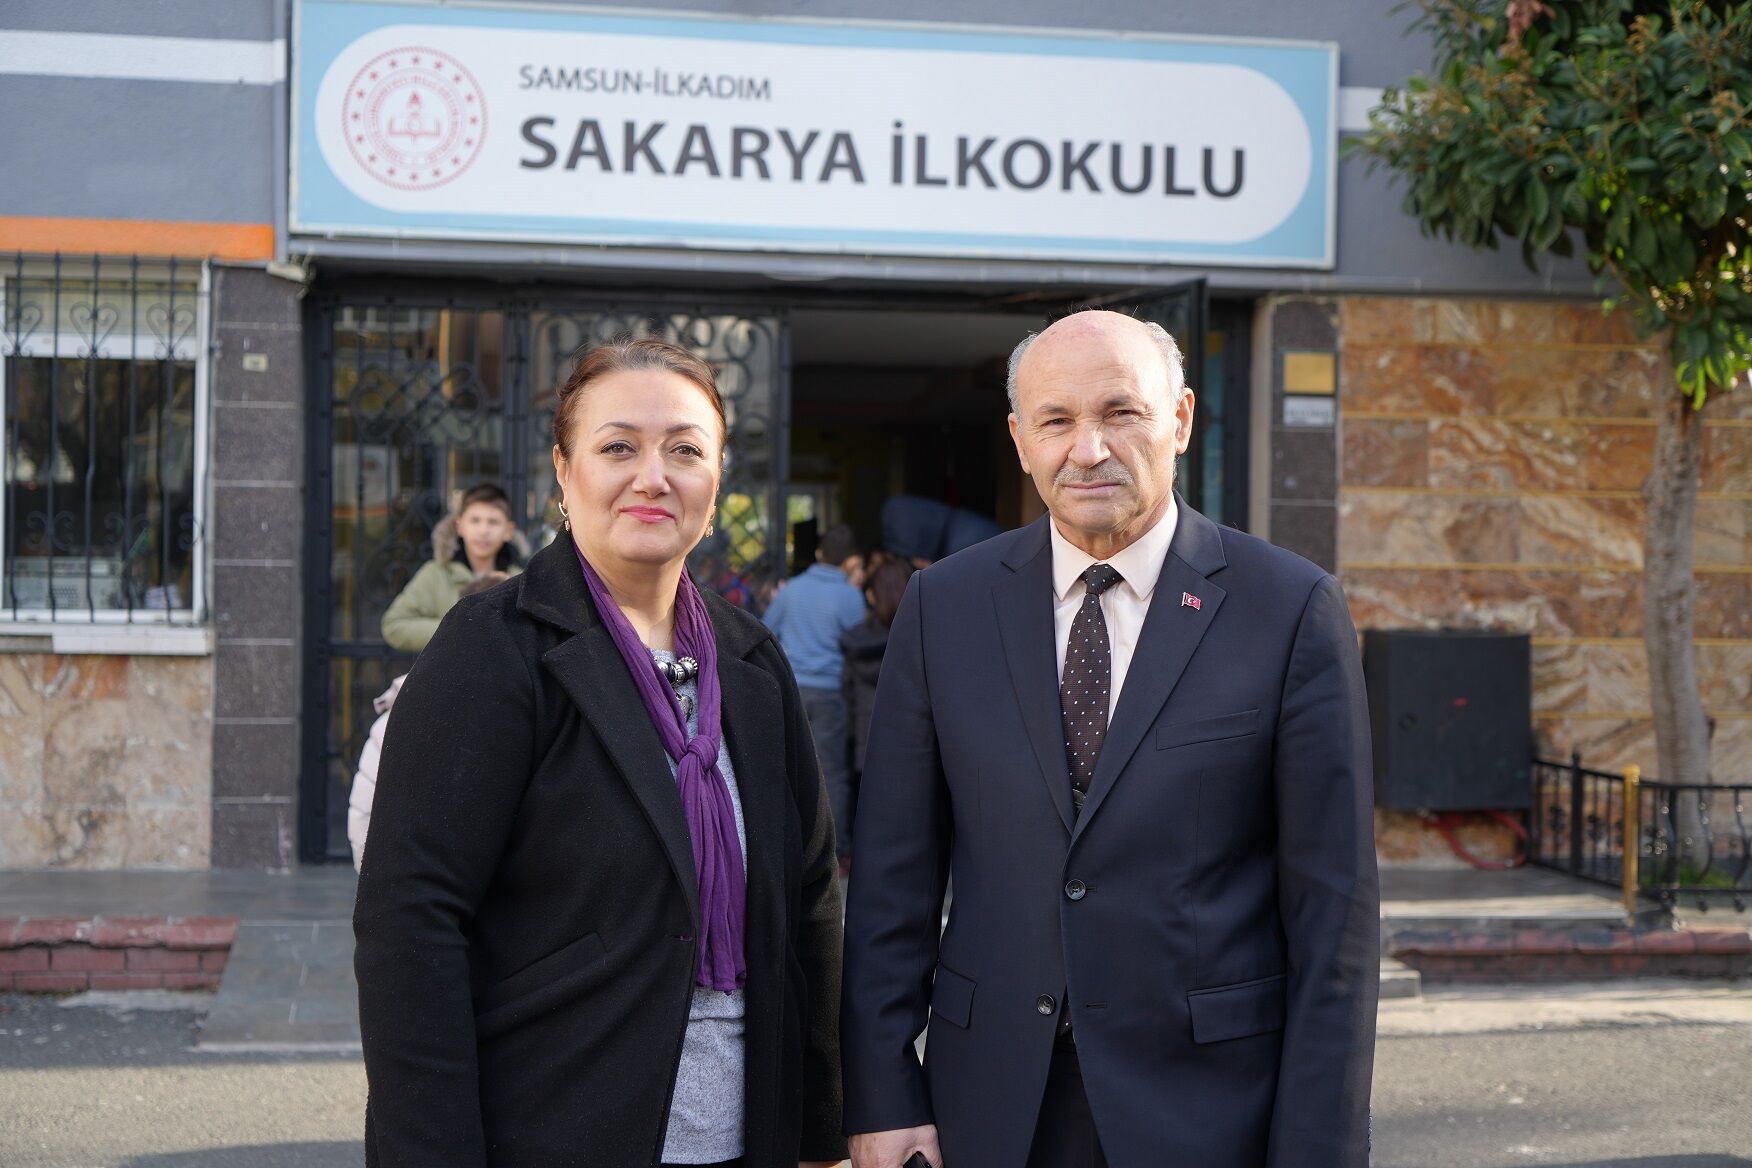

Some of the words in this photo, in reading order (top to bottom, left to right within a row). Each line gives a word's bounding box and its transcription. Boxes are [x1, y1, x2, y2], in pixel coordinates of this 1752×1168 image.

[519, 66, 772, 100] SAMSUN-İLKADIM
[519, 116, 867, 184] SAKARYA
[891, 120, 1246, 199] İLKOKULU
